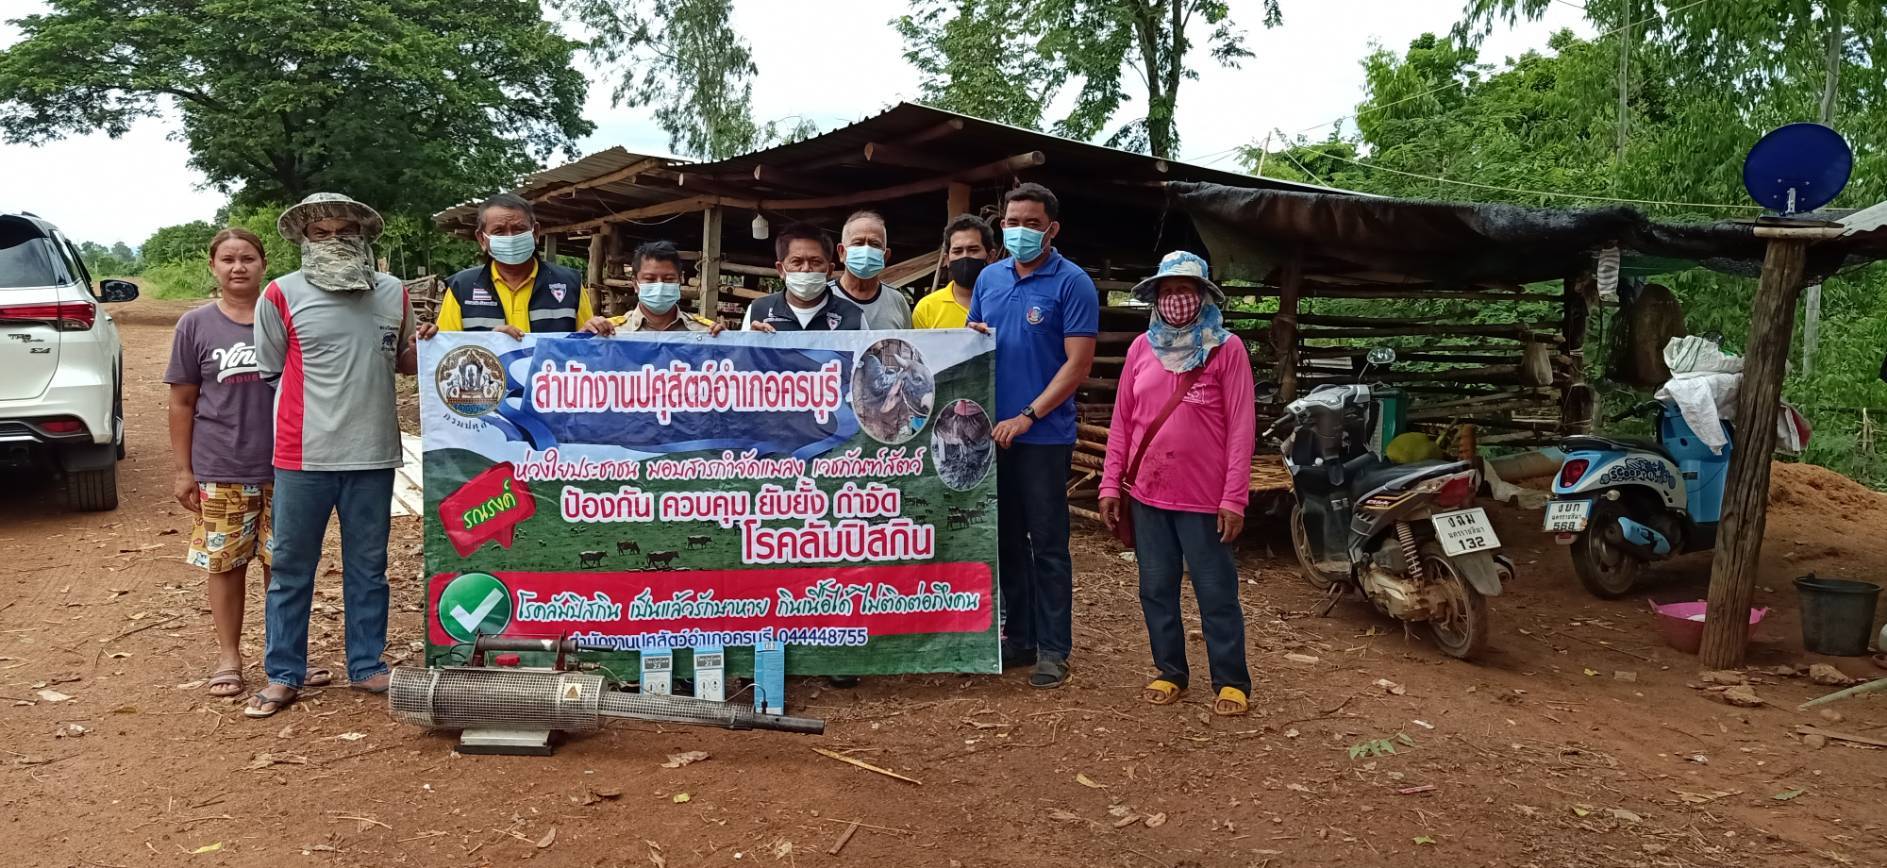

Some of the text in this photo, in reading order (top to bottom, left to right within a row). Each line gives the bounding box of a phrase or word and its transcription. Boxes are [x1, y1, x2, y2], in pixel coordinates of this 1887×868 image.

[535, 361, 840, 421] สำนักงานปศุสัตว์อำเภอครบุรี
[514, 447, 925, 479] ห่วงใยประชาชน มอบสารกำจัดแมลง เวชภัณฑ์สัตว์
[463, 479, 516, 529] รณรงค์
[564, 481, 897, 525] ป้องกัน ควบคุม ยับยั้ง กำจัด
[743, 518, 932, 561] โรคลัมปิสกิน
[1458, 536, 1487, 551] 132
[518, 579, 979, 621] โรคลัมปิสกิน เป็นแล้วรักษาหาย กินเนื้อได้ ไม่ติดต่อถึงคน
[779, 628, 867, 645] 044448755
